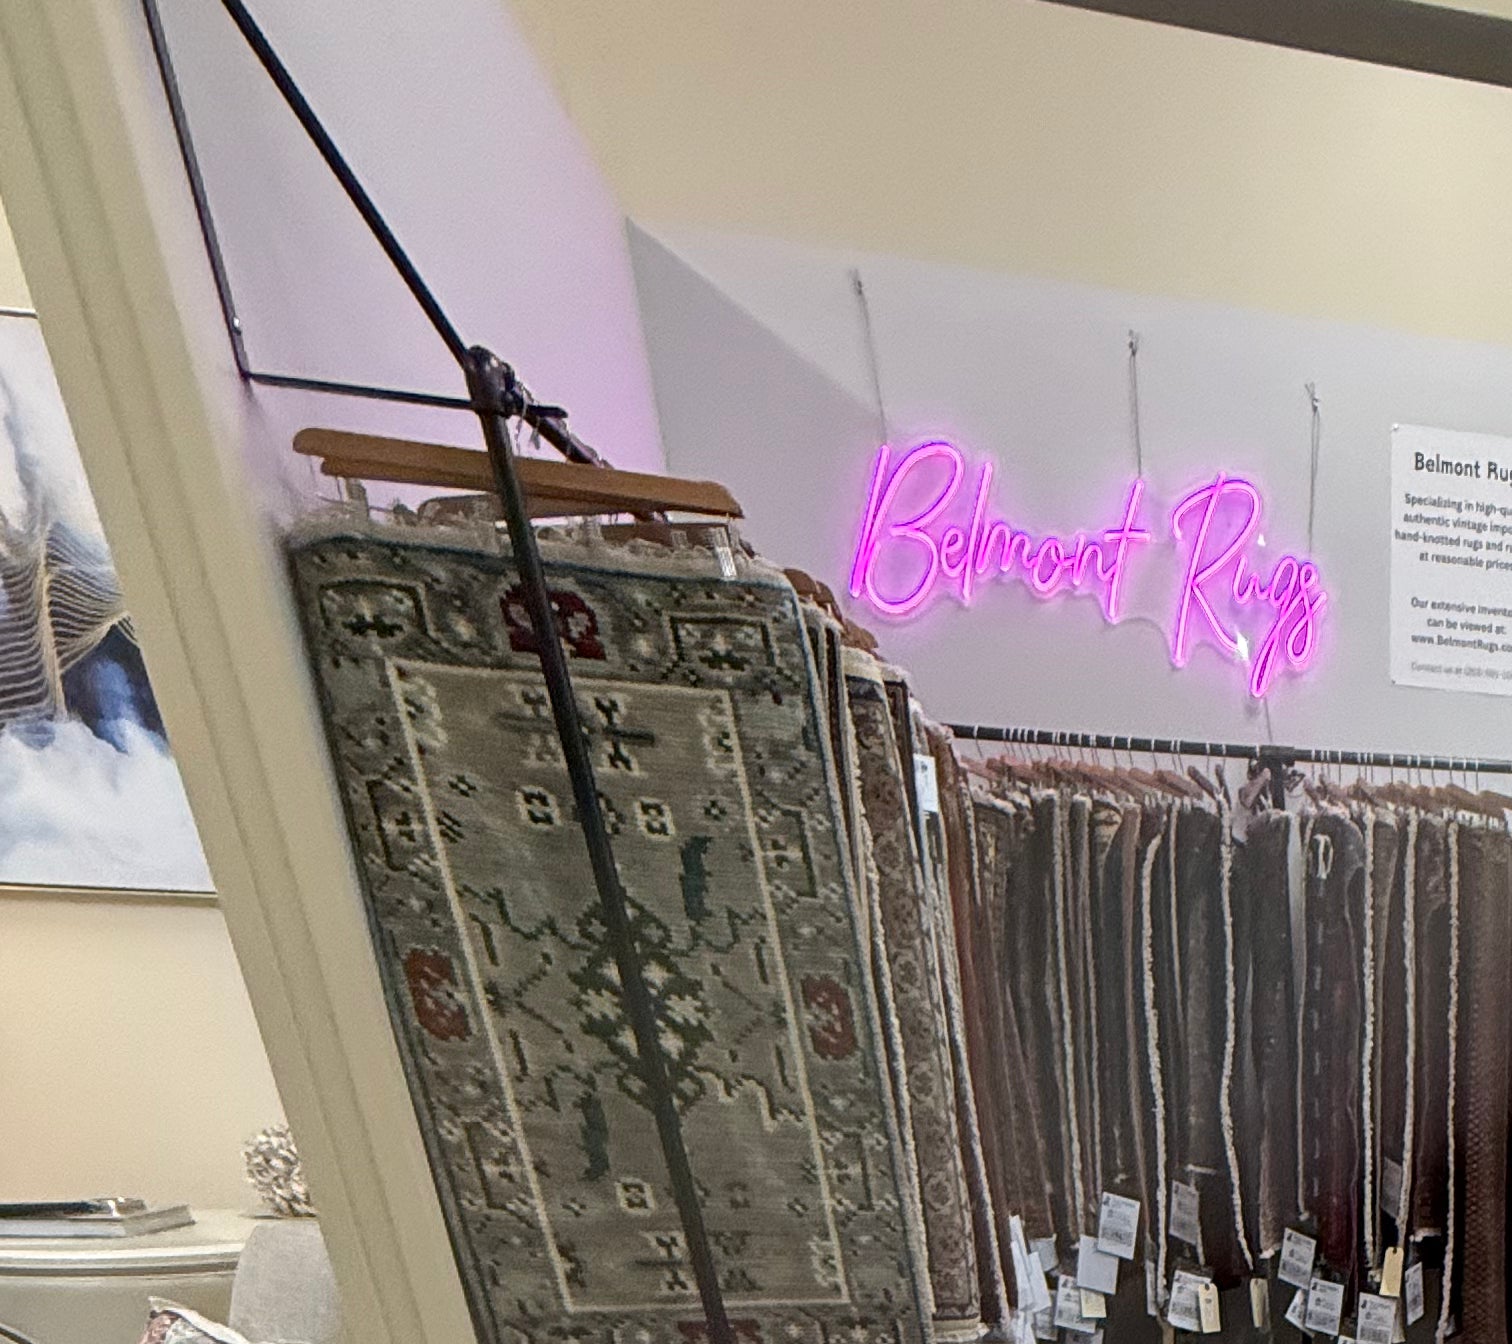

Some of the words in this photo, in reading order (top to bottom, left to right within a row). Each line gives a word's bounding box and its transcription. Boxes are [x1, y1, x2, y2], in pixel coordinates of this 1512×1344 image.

[1414, 452, 1481, 478] Belmont
[1405, 493, 1462, 513] Specializing
[1464, 500, 1474, 511] in
[1403, 513, 1450, 527] authentic
[1452, 518, 1488, 533] vintage
[1395, 530, 1460, 547] hand-knotted
[1463, 539, 1483, 551] rugs
[1486, 541, 1503, 552] and
[850, 441, 1152, 624] Belmont
[1172, 472, 1327, 698] Rugs
[1419, 552, 1429, 562] at
[1431, 553, 1484, 567] reasonable
[1411, 597, 1429, 609] Our
[1431, 601, 1476, 614] extensive
[1427, 618, 1444, 628] can
[1446, 618, 1458, 629] be
[1460, 621, 1493, 633] viewed
